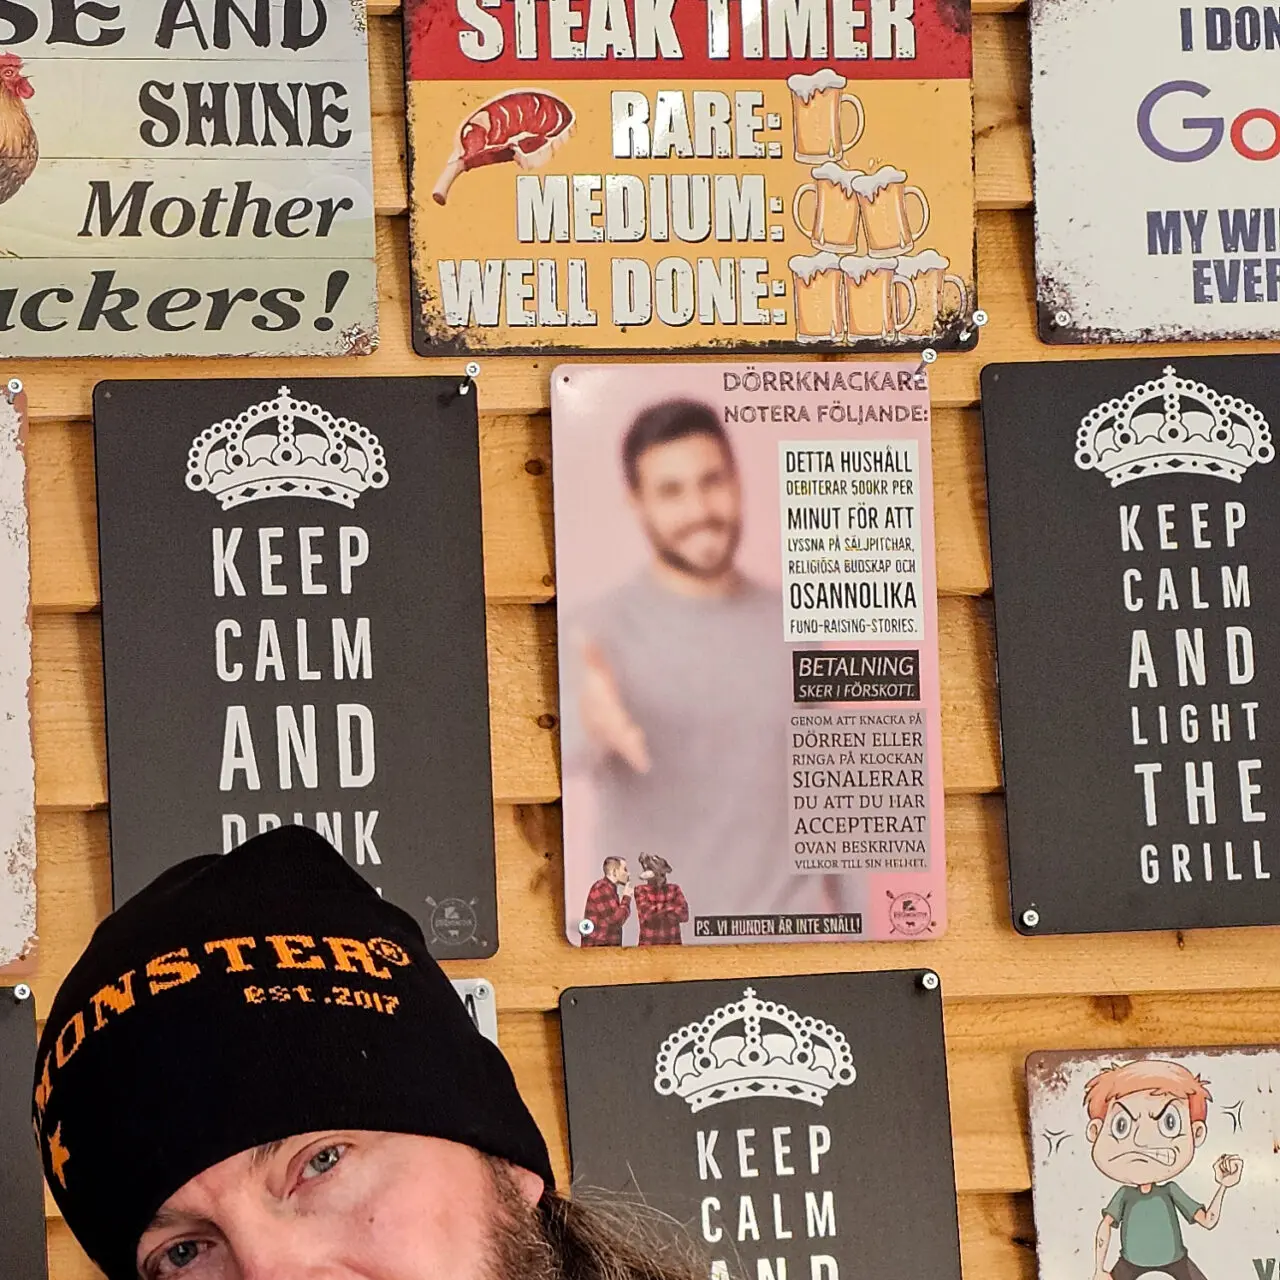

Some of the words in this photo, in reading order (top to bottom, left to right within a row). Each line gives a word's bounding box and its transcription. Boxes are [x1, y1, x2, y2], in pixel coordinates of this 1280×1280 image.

[155, 0, 329, 51] AND
[458, 0, 684, 62] STEAK
[706, 0, 916, 61] TIMER
[1180, 8, 1193, 51] I
[138, 80, 352, 149] SHINE
[610, 90, 783, 160] RARE:
[78, 180, 354, 239] Mother
[516, 174, 785, 244] MEDIUM:
[1146, 209, 1208, 255] MY
[437, 258, 598, 329] WELL
[611, 256, 788, 327] DONE:
[724, 404, 810, 423] NOTERA
[817, 400, 928, 425] FÖLJANDE:
[786, 451, 835, 473] DETTA
[840, 445, 913, 473] HUSHÅLL
[786, 480, 847, 495] DEBITERAR
[851, 480, 888, 495] 500KR
[892, 479, 913, 495] PER
[788, 507, 841, 530] MINUT
[848, 502, 879, 529] FÖR
[885, 507, 914, 529] ATT
[1120, 501, 1247, 552] KEEP
[212, 526, 371, 598] KEEP
[788, 538, 825, 552] LYSSNA
[829, 534, 841, 551] PÅ
[788, 556, 841, 574] RELIGIÖSA
[844, 559, 891, 573] BUDSKAP
[895, 559, 916, 573] OCH
[790, 581, 917, 609] OSANNOLIKA
[1123, 564, 1251, 613] CALM
[215, 617, 374, 682] CALM
[799, 656, 914, 677] BETALNING
[1128, 625, 1255, 689] AND
[799, 684, 832, 698] SKER
[836, 685, 840, 697] I
[844, 681, 915, 697] FÖRSKOTT.
[790, 716, 833, 726] GENOM
[836, 716, 856, 725] ATT
[859, 715, 906, 725] KNACKA
[909, 712, 923, 724] PÅ
[792, 730, 866, 748] DÖRREN
[872, 732, 923, 747] ELLER
[1131, 701, 1260, 746] LIGHT
[219, 703, 378, 791] AND
[792, 754, 835, 766] RINGA
[840, 750, 856, 765] PÅ
[860, 752, 923, 765] KLOCKAN
[793, 770, 924, 788] SIGNALERAR
[1134, 758, 1267, 828] THE
[794, 795, 818, 810] DU
[823, 795, 855, 809] ATT
[859, 794, 883, 809] DU
[889, 794, 925, 808] HAR
[222, 811, 382, 865] DNK
[794, 815, 926, 835] ACCEPTERAT
[794, 841, 836, 854] OVAN
[842, 840, 926, 854] BESKRIVNA
[795, 859, 839, 869] VILLKOR
[841, 859, 862, 869] TILL
[865, 858, 881, 868] SIN
[1140, 840, 1271, 885] GRILL
[696, 920, 713, 936] PS.
[717, 919, 727, 935] VI
[731, 918, 775, 935] HUNDEN
[778, 916, 792, 934] ÄR
[796, 918, 819, 934] INTE
[823, 915, 860, 934] SNÄLL!
[696, 1125, 832, 1180] KEEP
[700, 1190, 837, 1243] CALM
